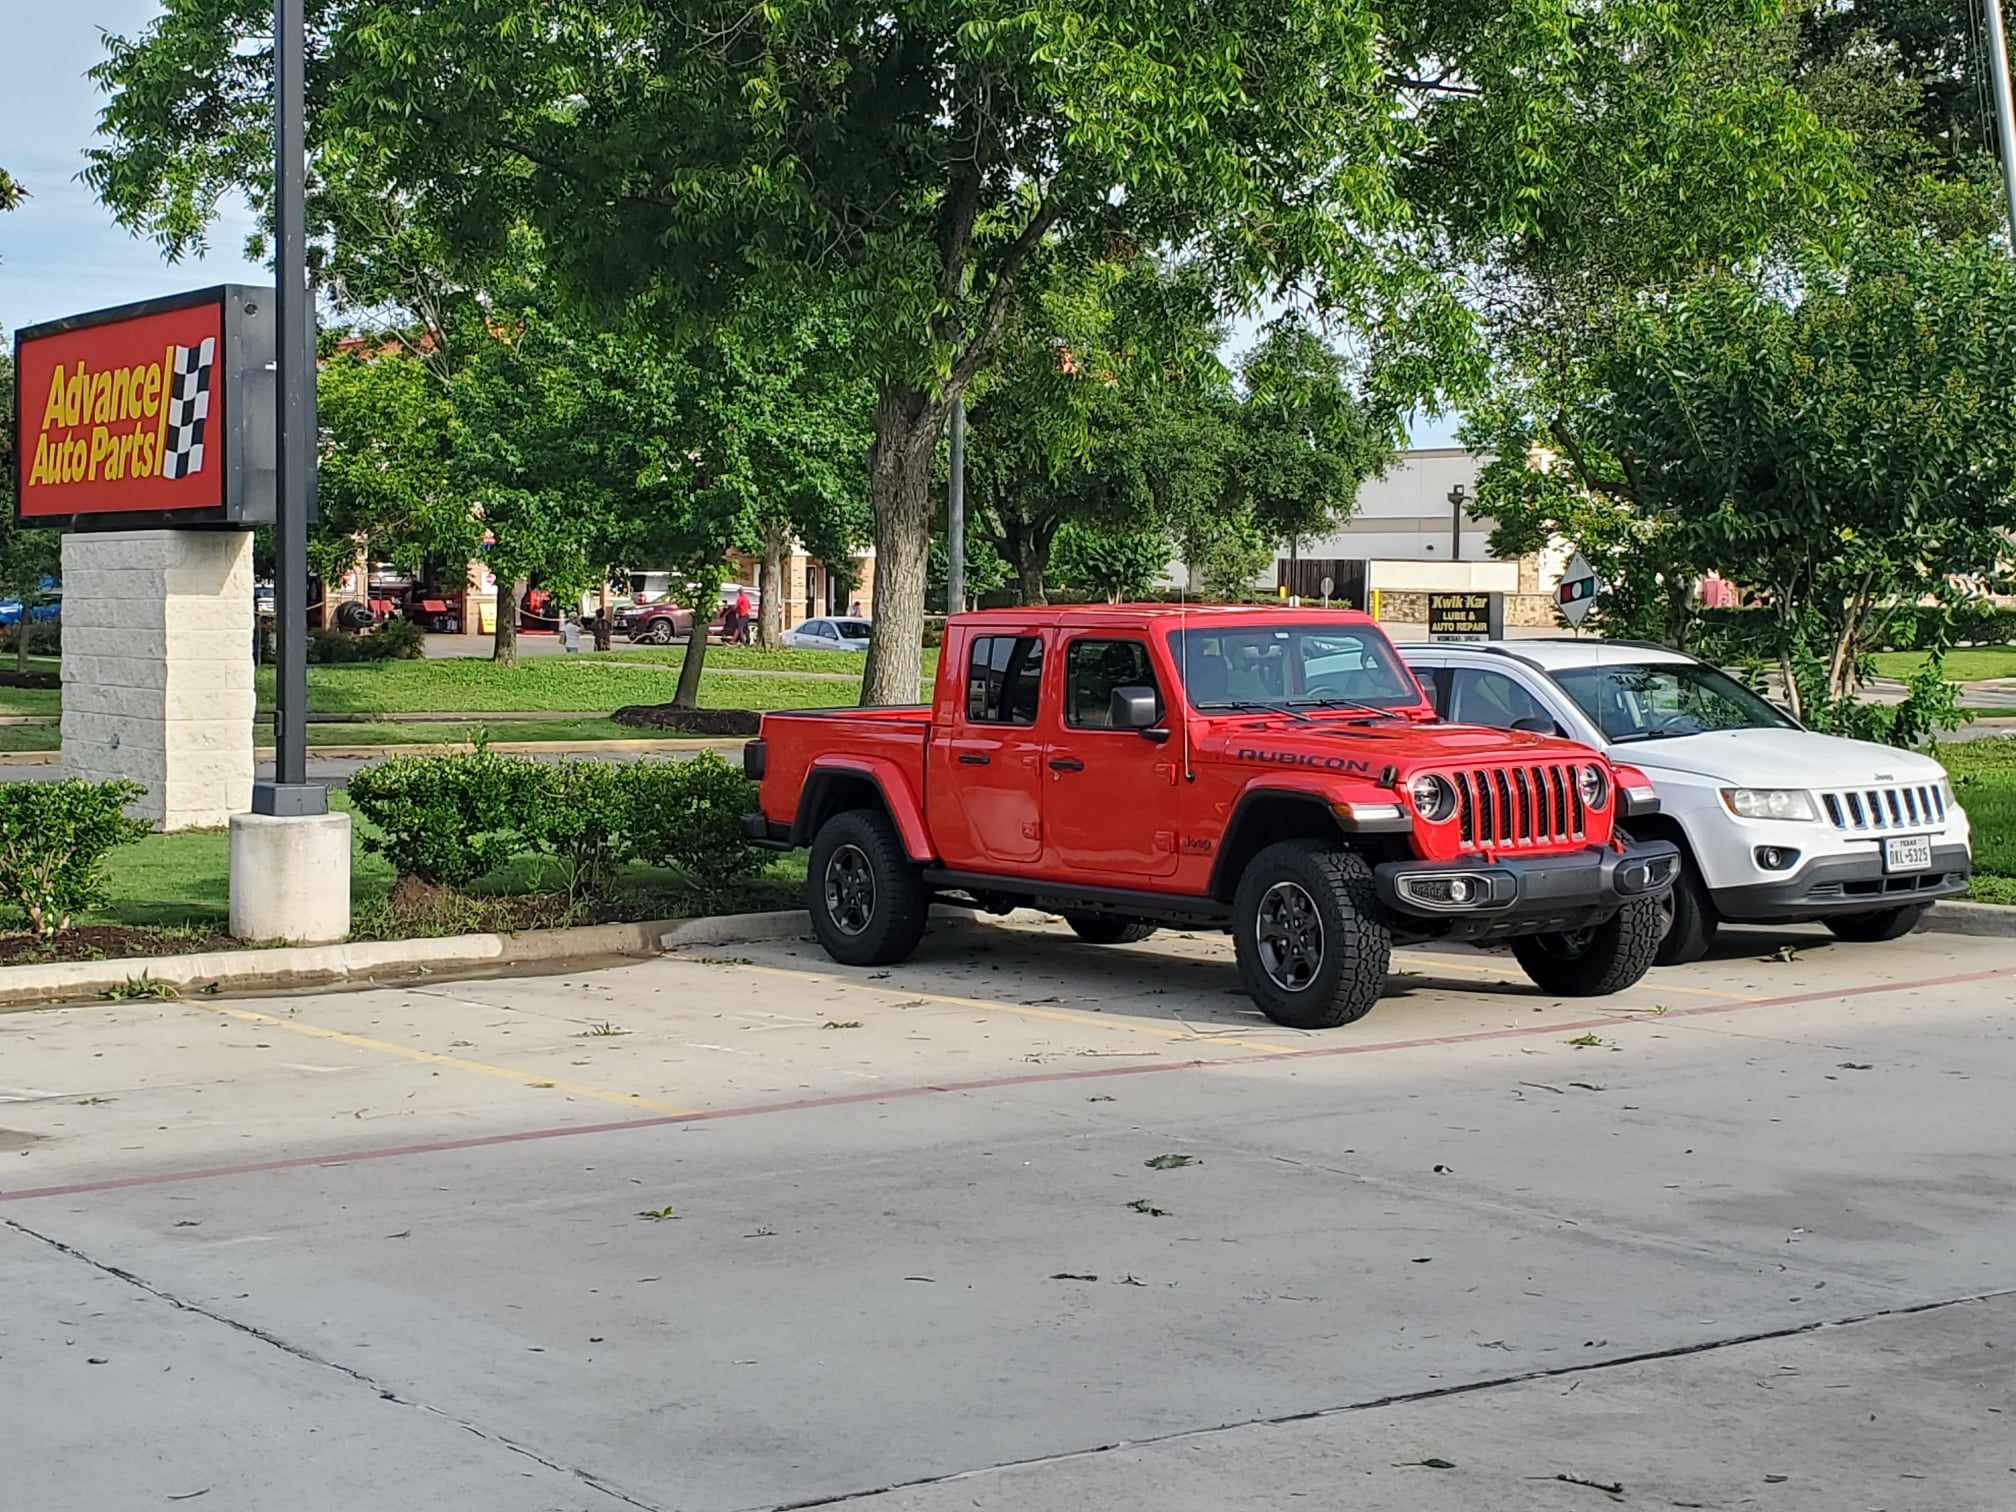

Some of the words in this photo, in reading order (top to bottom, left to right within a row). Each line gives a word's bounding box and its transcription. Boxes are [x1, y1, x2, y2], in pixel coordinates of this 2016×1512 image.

[41, 360, 162, 431] Advance
[28, 432, 88, 487] Auto
[88, 422, 155, 481] Parts
[1432, 595, 1463, 608] Kwik
[1465, 595, 1488, 608] Kar
[1443, 611, 1466, 620] LUBE
[1468, 611, 1475, 620] &
[1431, 622, 1454, 631] AUTO
[1456, 622, 1487, 631] REPAIR
[1237, 749, 1369, 772] RUBICON
